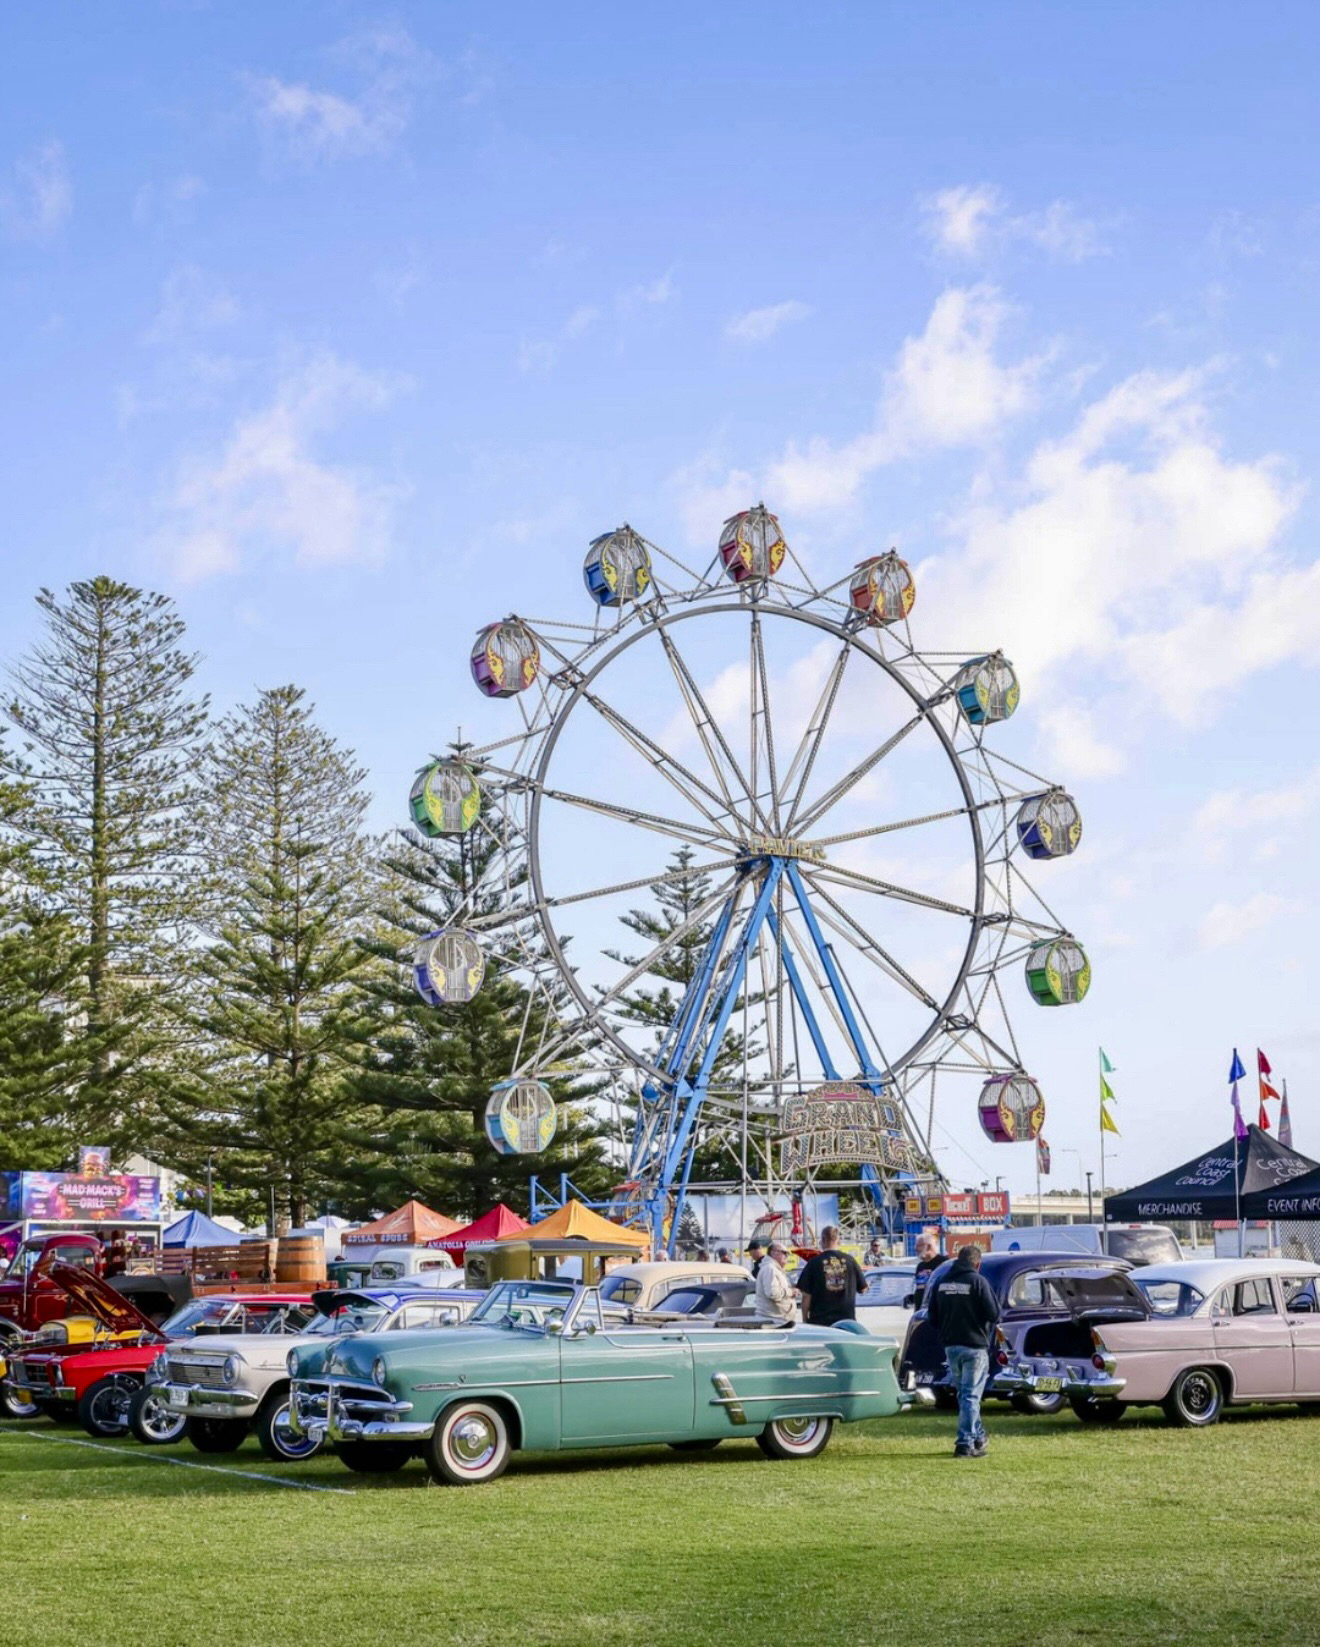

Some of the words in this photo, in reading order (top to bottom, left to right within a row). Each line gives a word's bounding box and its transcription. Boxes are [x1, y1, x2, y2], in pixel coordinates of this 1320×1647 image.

[784, 1097, 902, 1132] GRAND
[781, 1129, 911, 1175] WHEEL
[1198, 1157, 1244, 1168] Central
[1256, 1157, 1308, 1170] Central
[1195, 1167, 1231, 1179] Coast
[1175, 1175, 1221, 1186] Council
[62, 1184, 85, 1195] MAD
[86, 1184, 121, 1197] MACK'S
[80, 1197, 105, 1209] GRILL
[983, 1196, 1003, 1213] BOX
[1138, 1202, 1203, 1216] MERCHANDISE
[1267, 1198, 1299, 1212] EVENT
[427, 1240, 464, 1249] ANATOLIA
